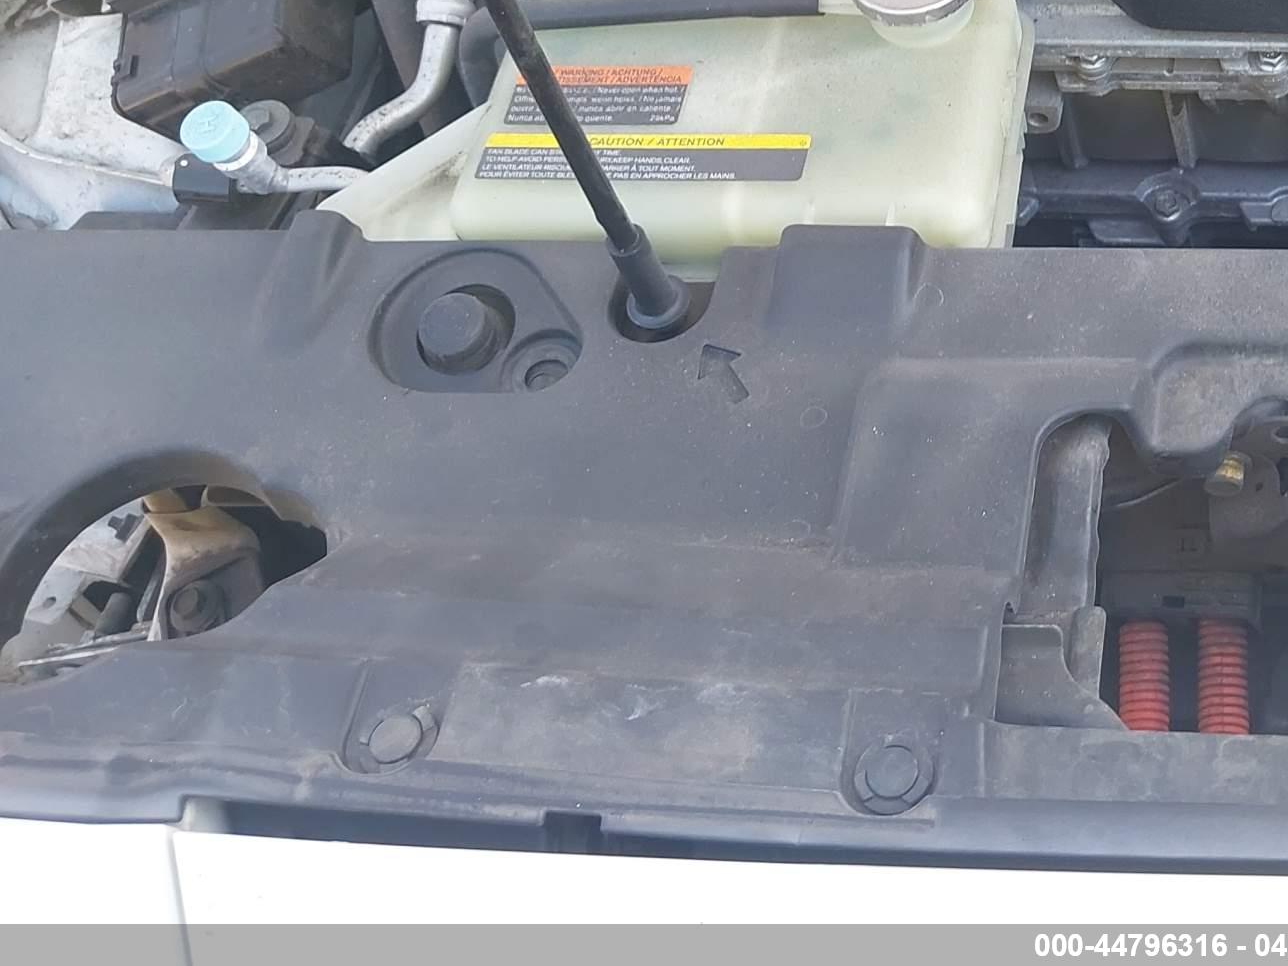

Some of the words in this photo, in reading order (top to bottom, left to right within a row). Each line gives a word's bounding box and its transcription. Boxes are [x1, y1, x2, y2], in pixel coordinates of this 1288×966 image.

[589, 137, 644, 146] CAUTION
[656, 137, 726, 146] ATTENTION
[479, 171, 502, 179] POUR
[530, 171, 555, 179] TOUTE
[612, 172, 630, 180] PAS
[630, 172, 642, 180] EN
[642, 172, 693, 180] APPROCHER
